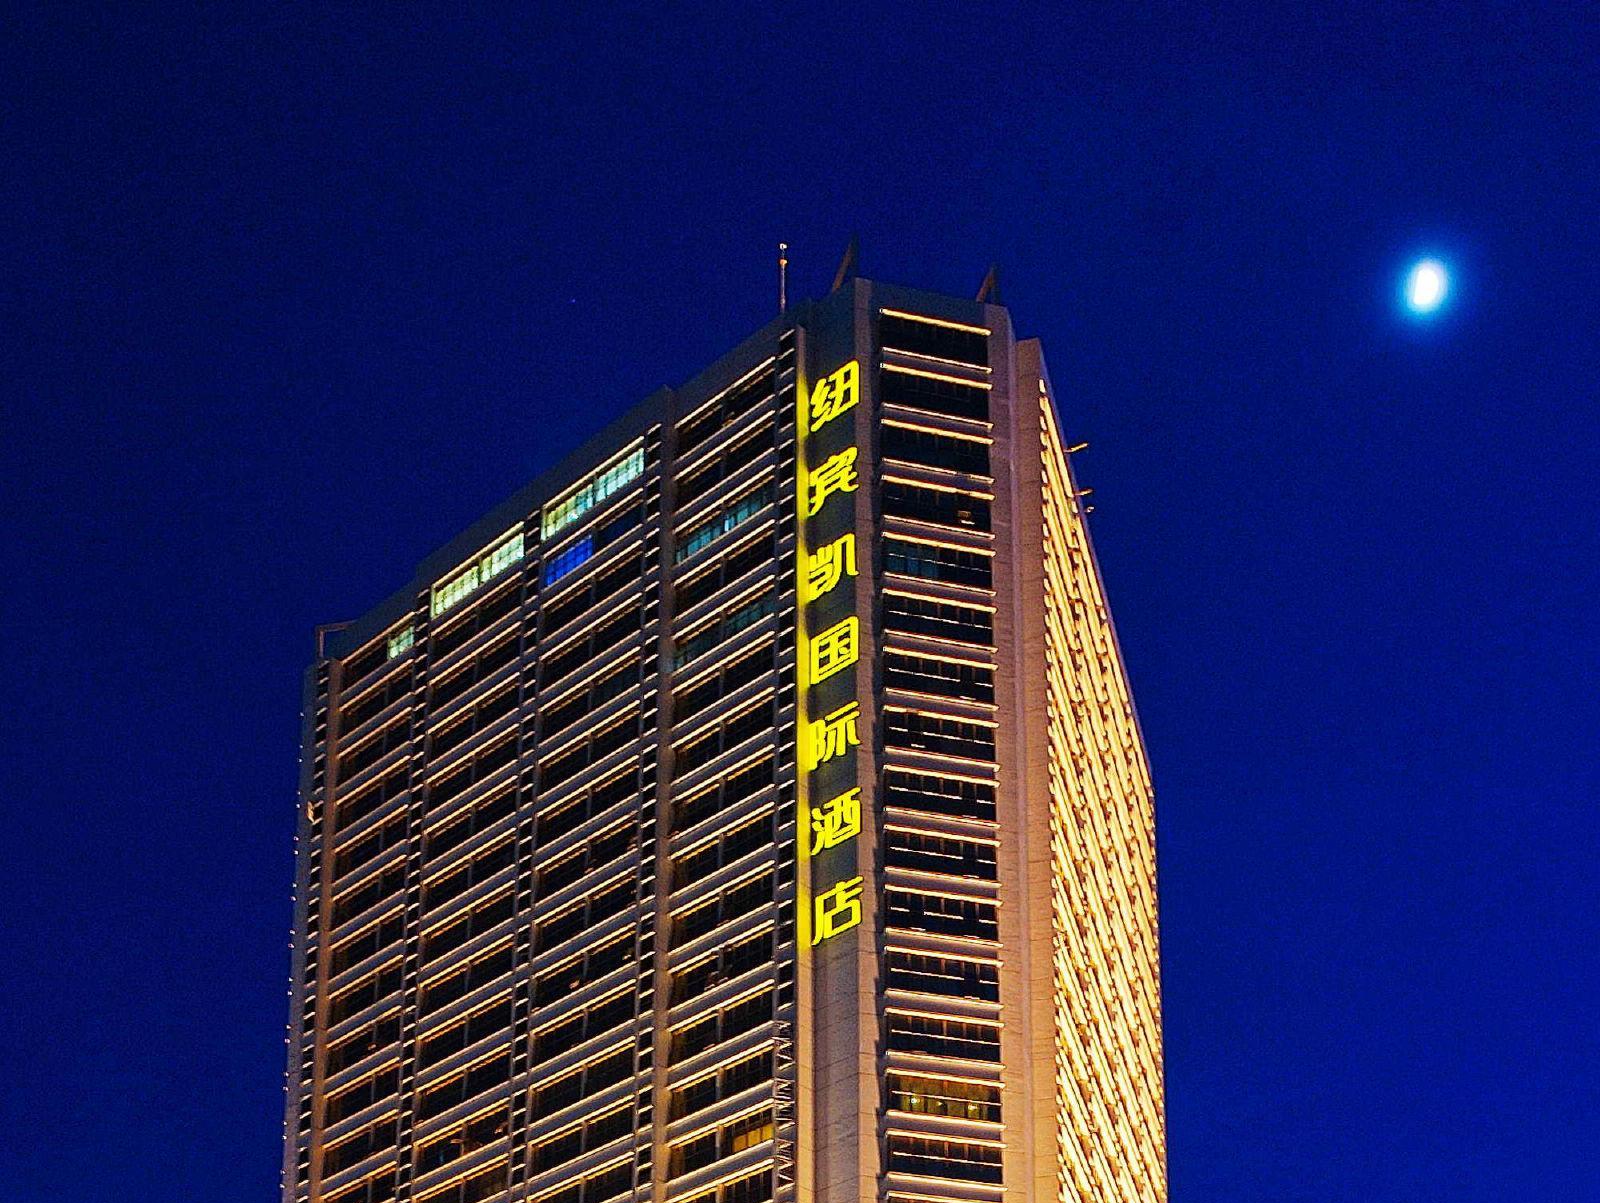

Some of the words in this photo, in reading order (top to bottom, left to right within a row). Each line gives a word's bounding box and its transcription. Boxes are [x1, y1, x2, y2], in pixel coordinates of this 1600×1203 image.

[808, 360, 864, 946] 纽宾凯国际酒店
